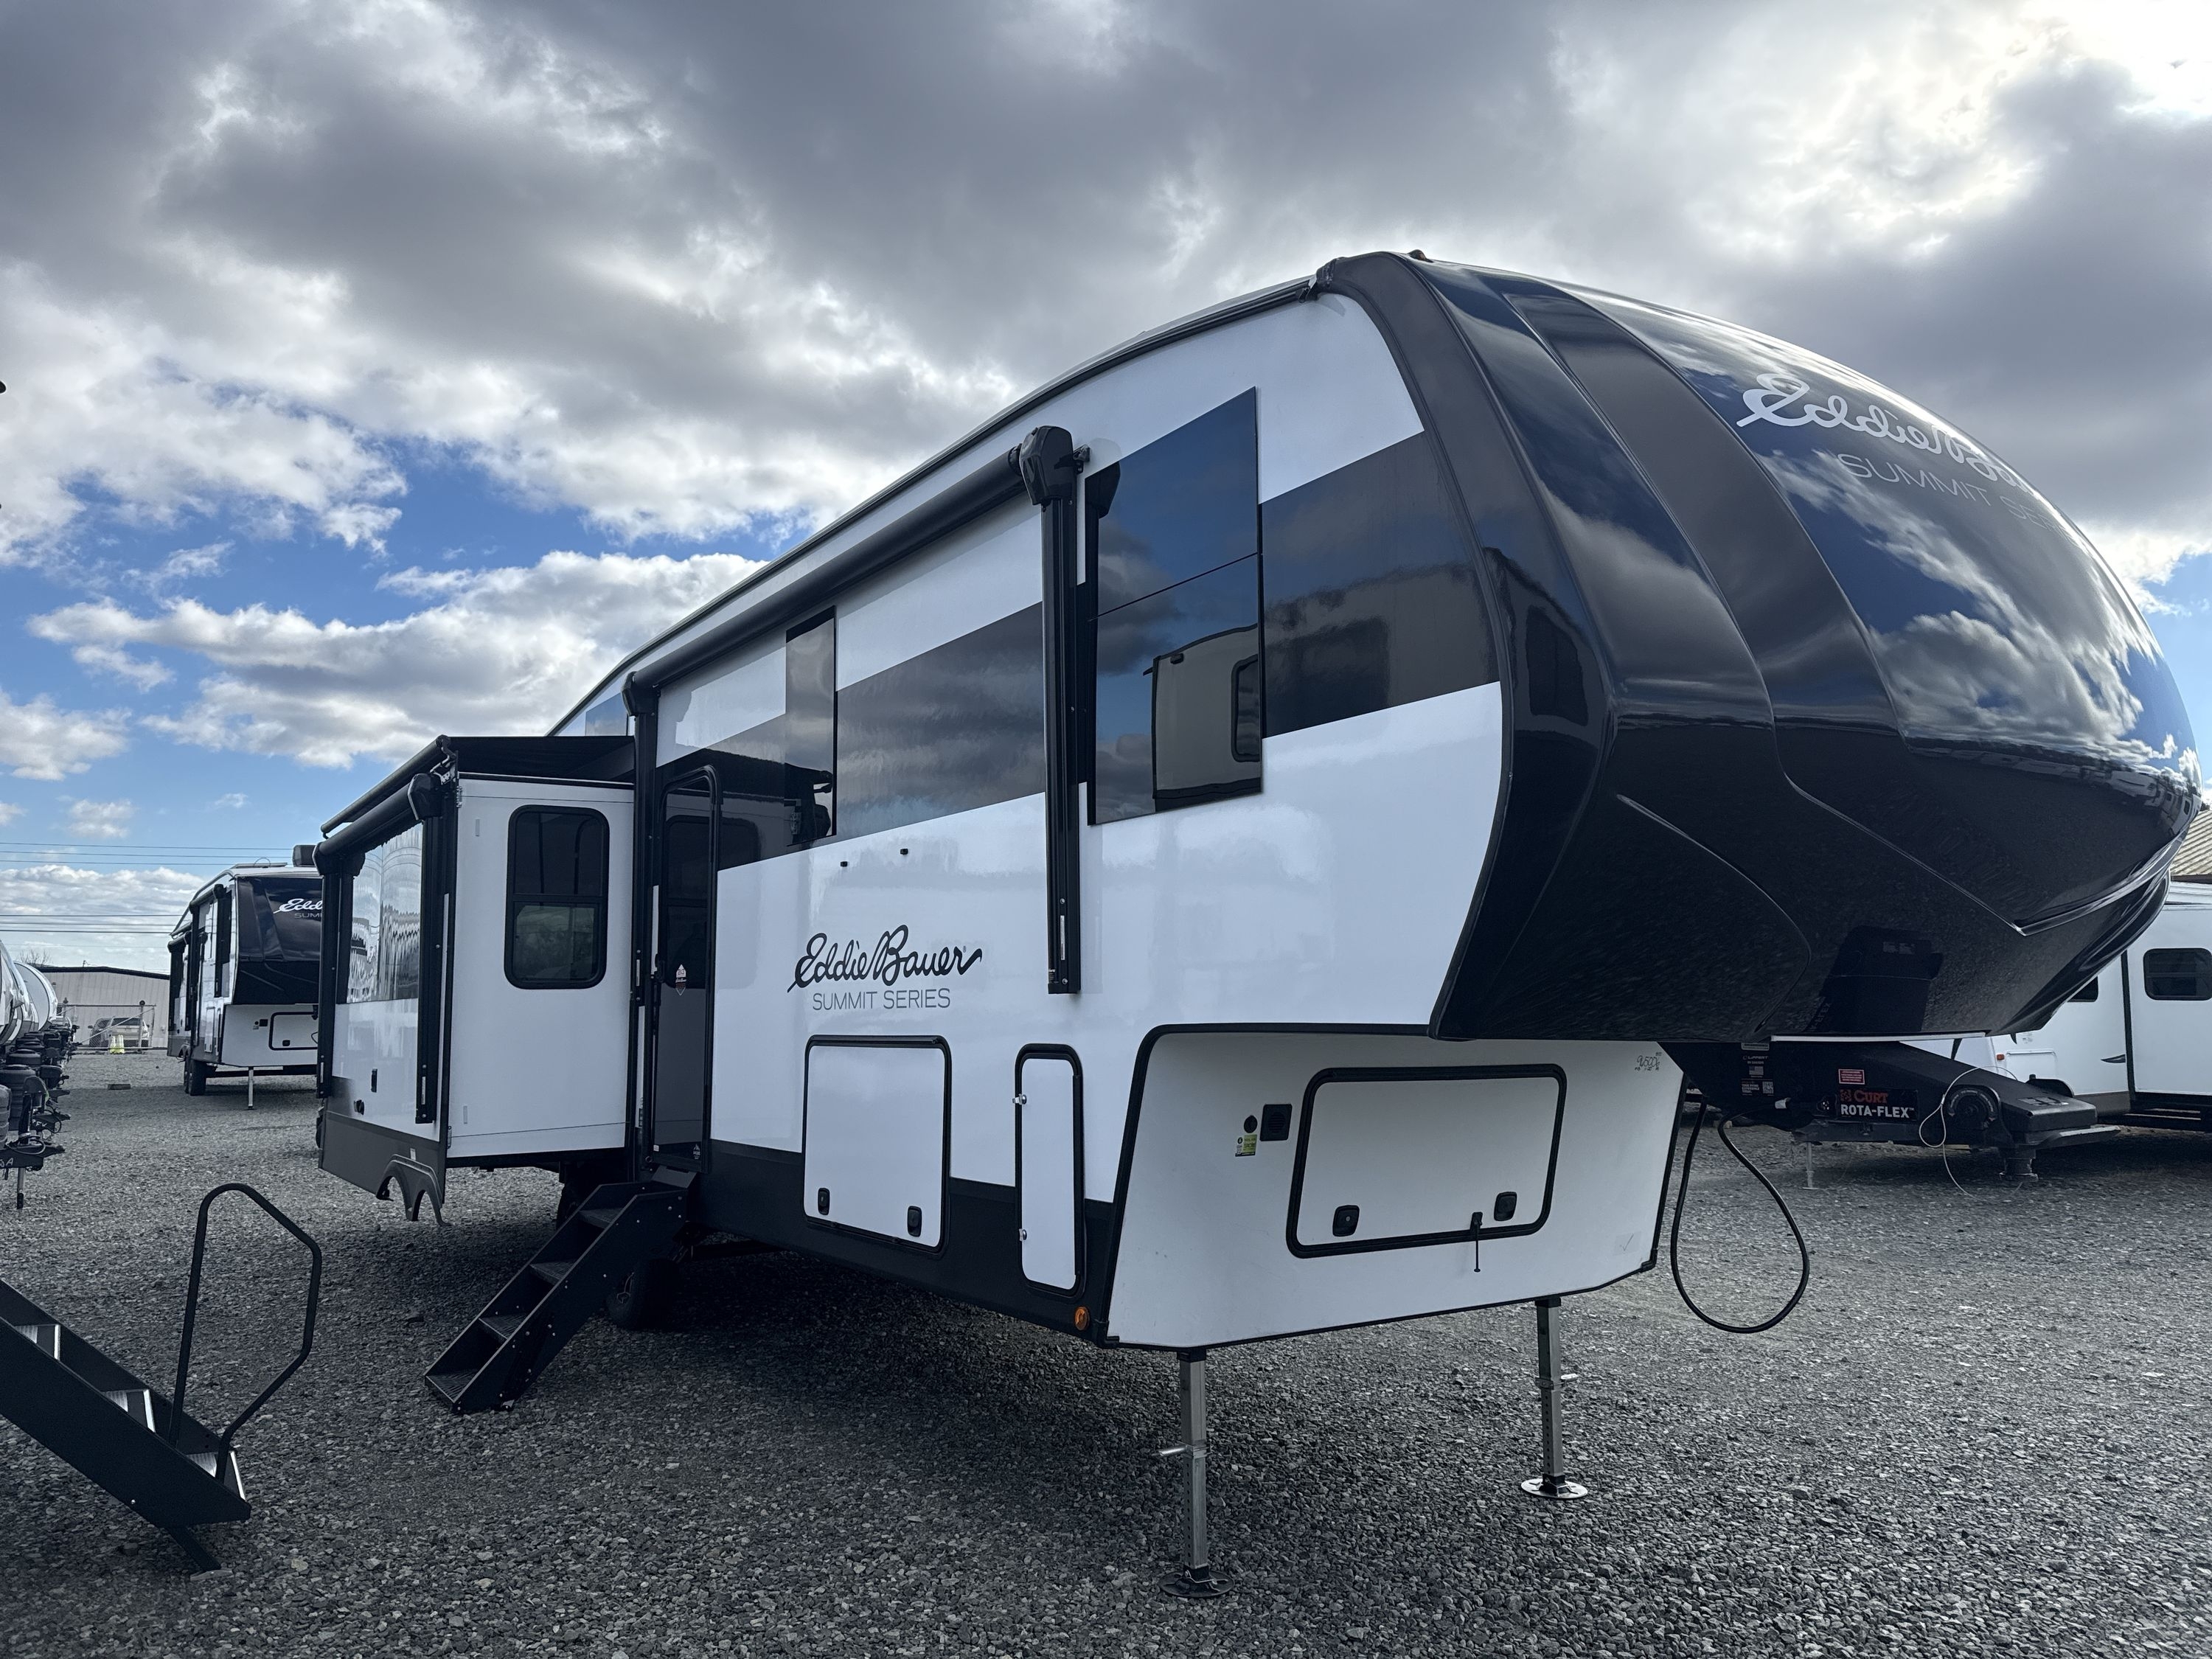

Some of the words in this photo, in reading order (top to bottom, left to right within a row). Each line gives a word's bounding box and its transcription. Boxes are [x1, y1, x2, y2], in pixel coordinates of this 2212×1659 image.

[1837, 453, 1991, 507] SUMMIT
[813, 991, 877, 1010] SUMMIT
[883, 987, 951, 1009] SERIES
